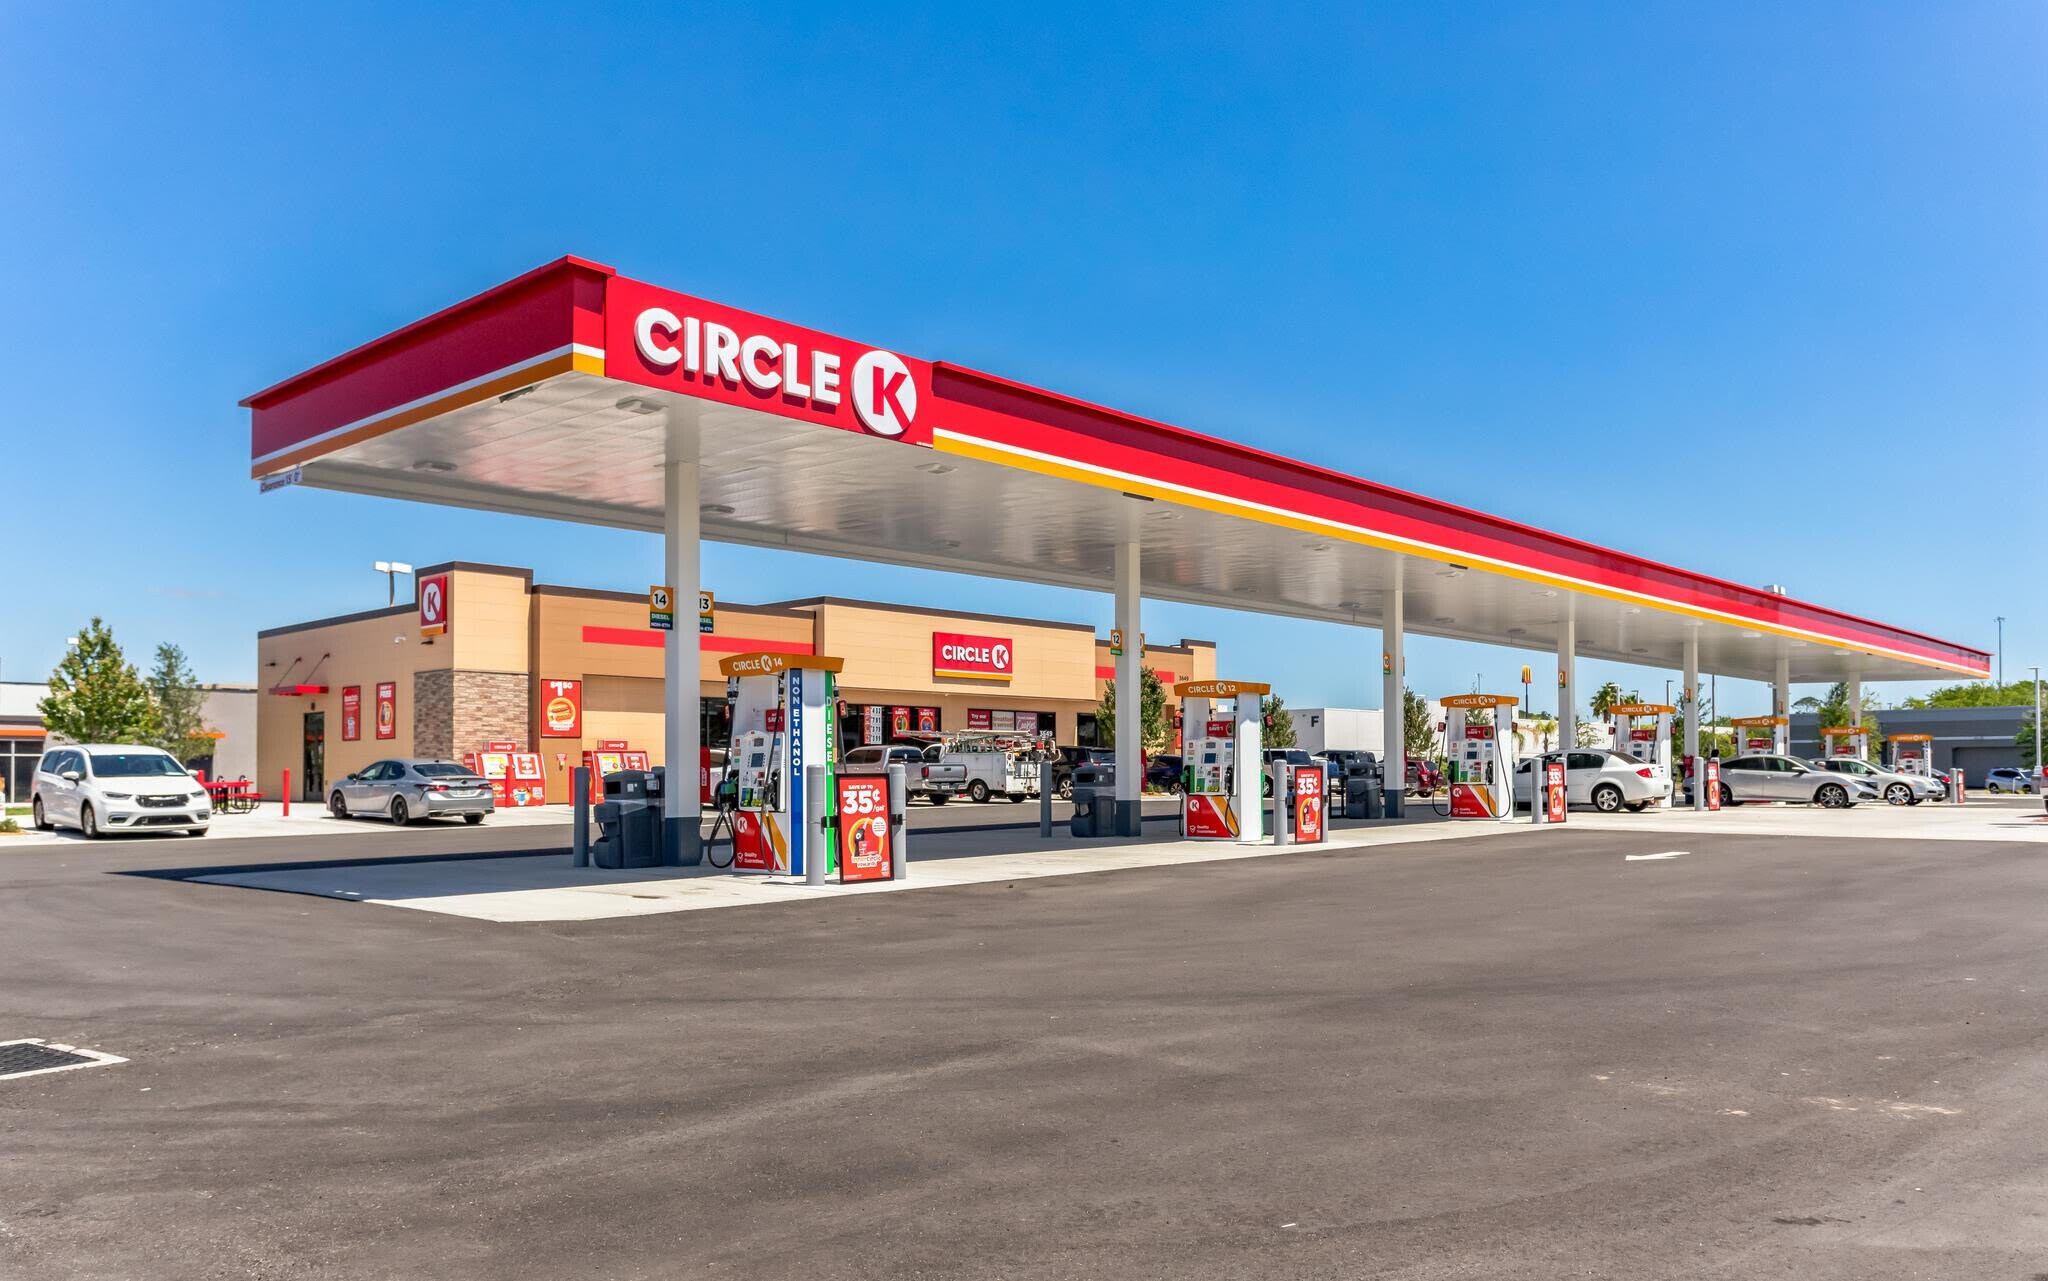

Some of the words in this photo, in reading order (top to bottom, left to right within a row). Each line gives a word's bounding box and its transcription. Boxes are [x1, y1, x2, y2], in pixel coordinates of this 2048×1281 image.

[634, 307, 840, 405] CIRCLE
[868, 361, 916, 434] K
[426, 588, 440, 619] K
[654, 593, 667, 606] 14
[699, 598, 710, 610] 13
[651, 613, 670, 621] DIESEL
[1112, 634, 1120, 644] 12
[942, 645, 990, 663] CIRCLE
[994, 647, 1008, 669] K
[732, 659, 761, 672] CIRCLE
[762, 656, 772, 671] K
[773, 657, 783, 667] 14
[792, 676, 801, 705] NON
[1188, 685, 1215, 694] CIRCLE
[1216, 682, 1226, 694] K
[1453, 698, 1478, 706] CIRCLE
[1478, 696, 1488, 705] K
[1311, 715, 1320, 727] F
[792, 708, 801, 776] ETHANOL
[825, 696, 833, 776] DIESEL
[1453, 788, 1462, 797] K
[1190, 800, 1199, 811] K
[739, 818, 747, 832] K
